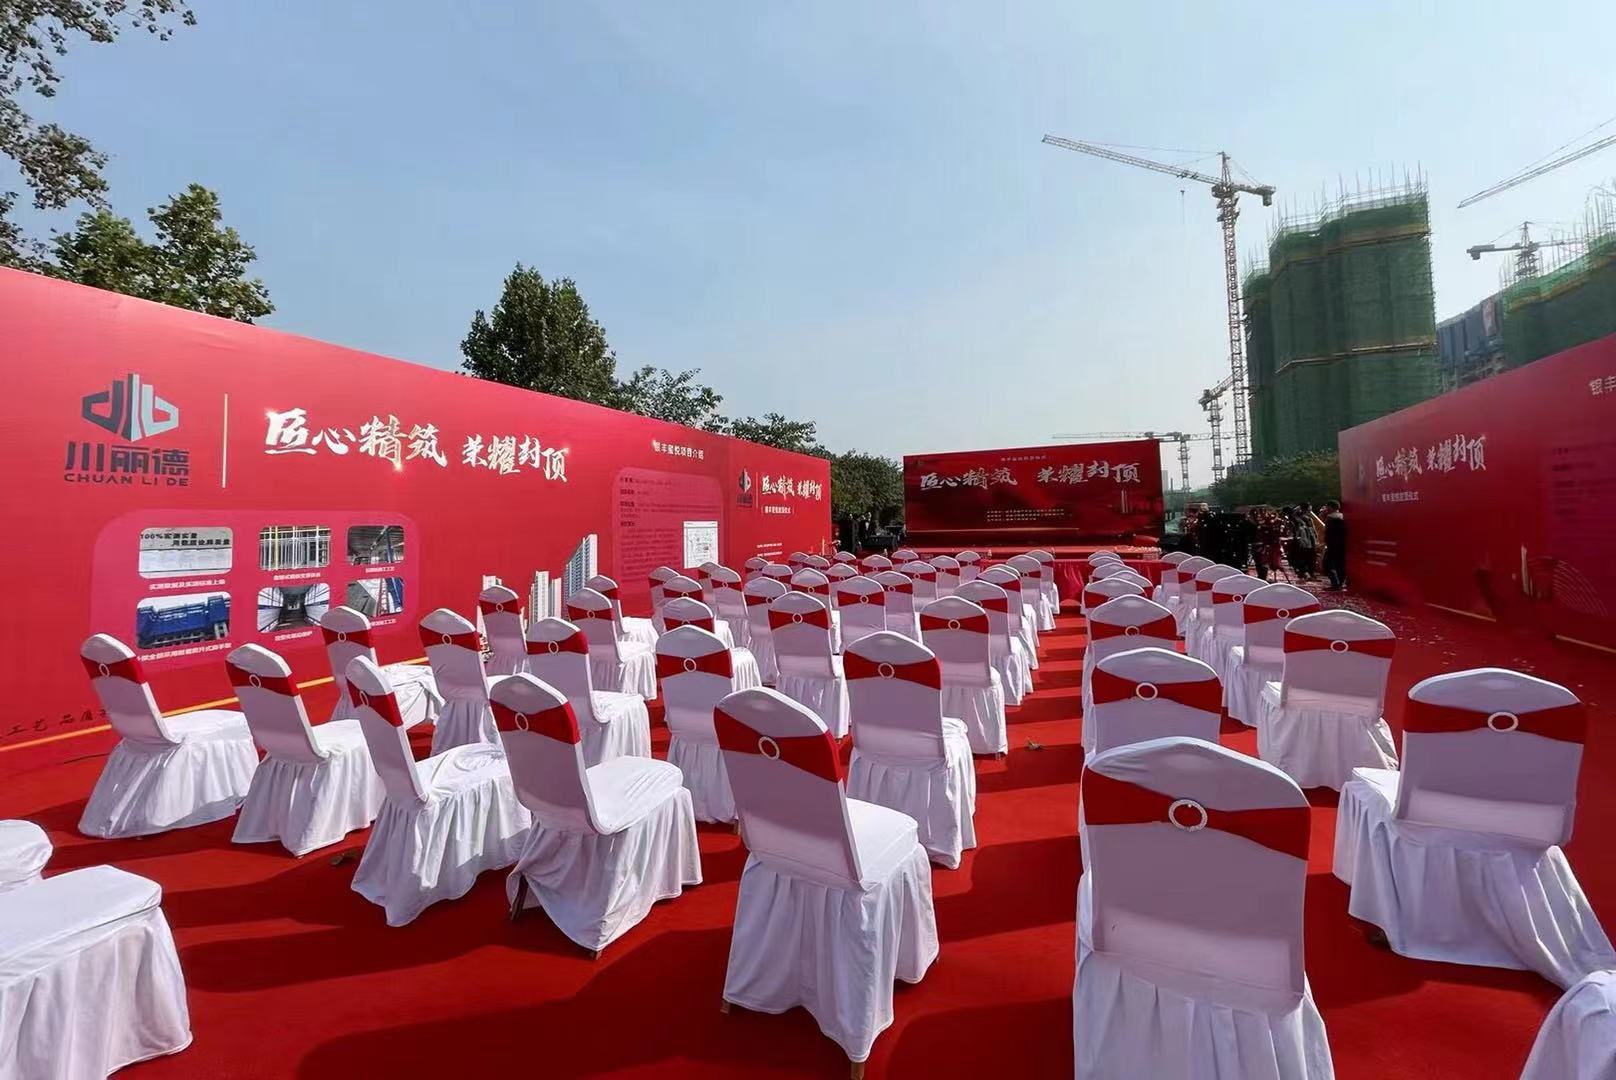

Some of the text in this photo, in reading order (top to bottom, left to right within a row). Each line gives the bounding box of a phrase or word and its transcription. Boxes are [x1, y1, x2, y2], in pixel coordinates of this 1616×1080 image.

[64, 441, 189, 475] 川丽德
[264, 408, 569, 483] 匠心精筑 荣耀封顶
[1376, 434, 1486, 482] 匠心精筑 荣耀封顶
[64, 473, 189, 486] CHUAN LI DE
[920, 460, 1141, 491] 匠心精筑 荣耀封顶
